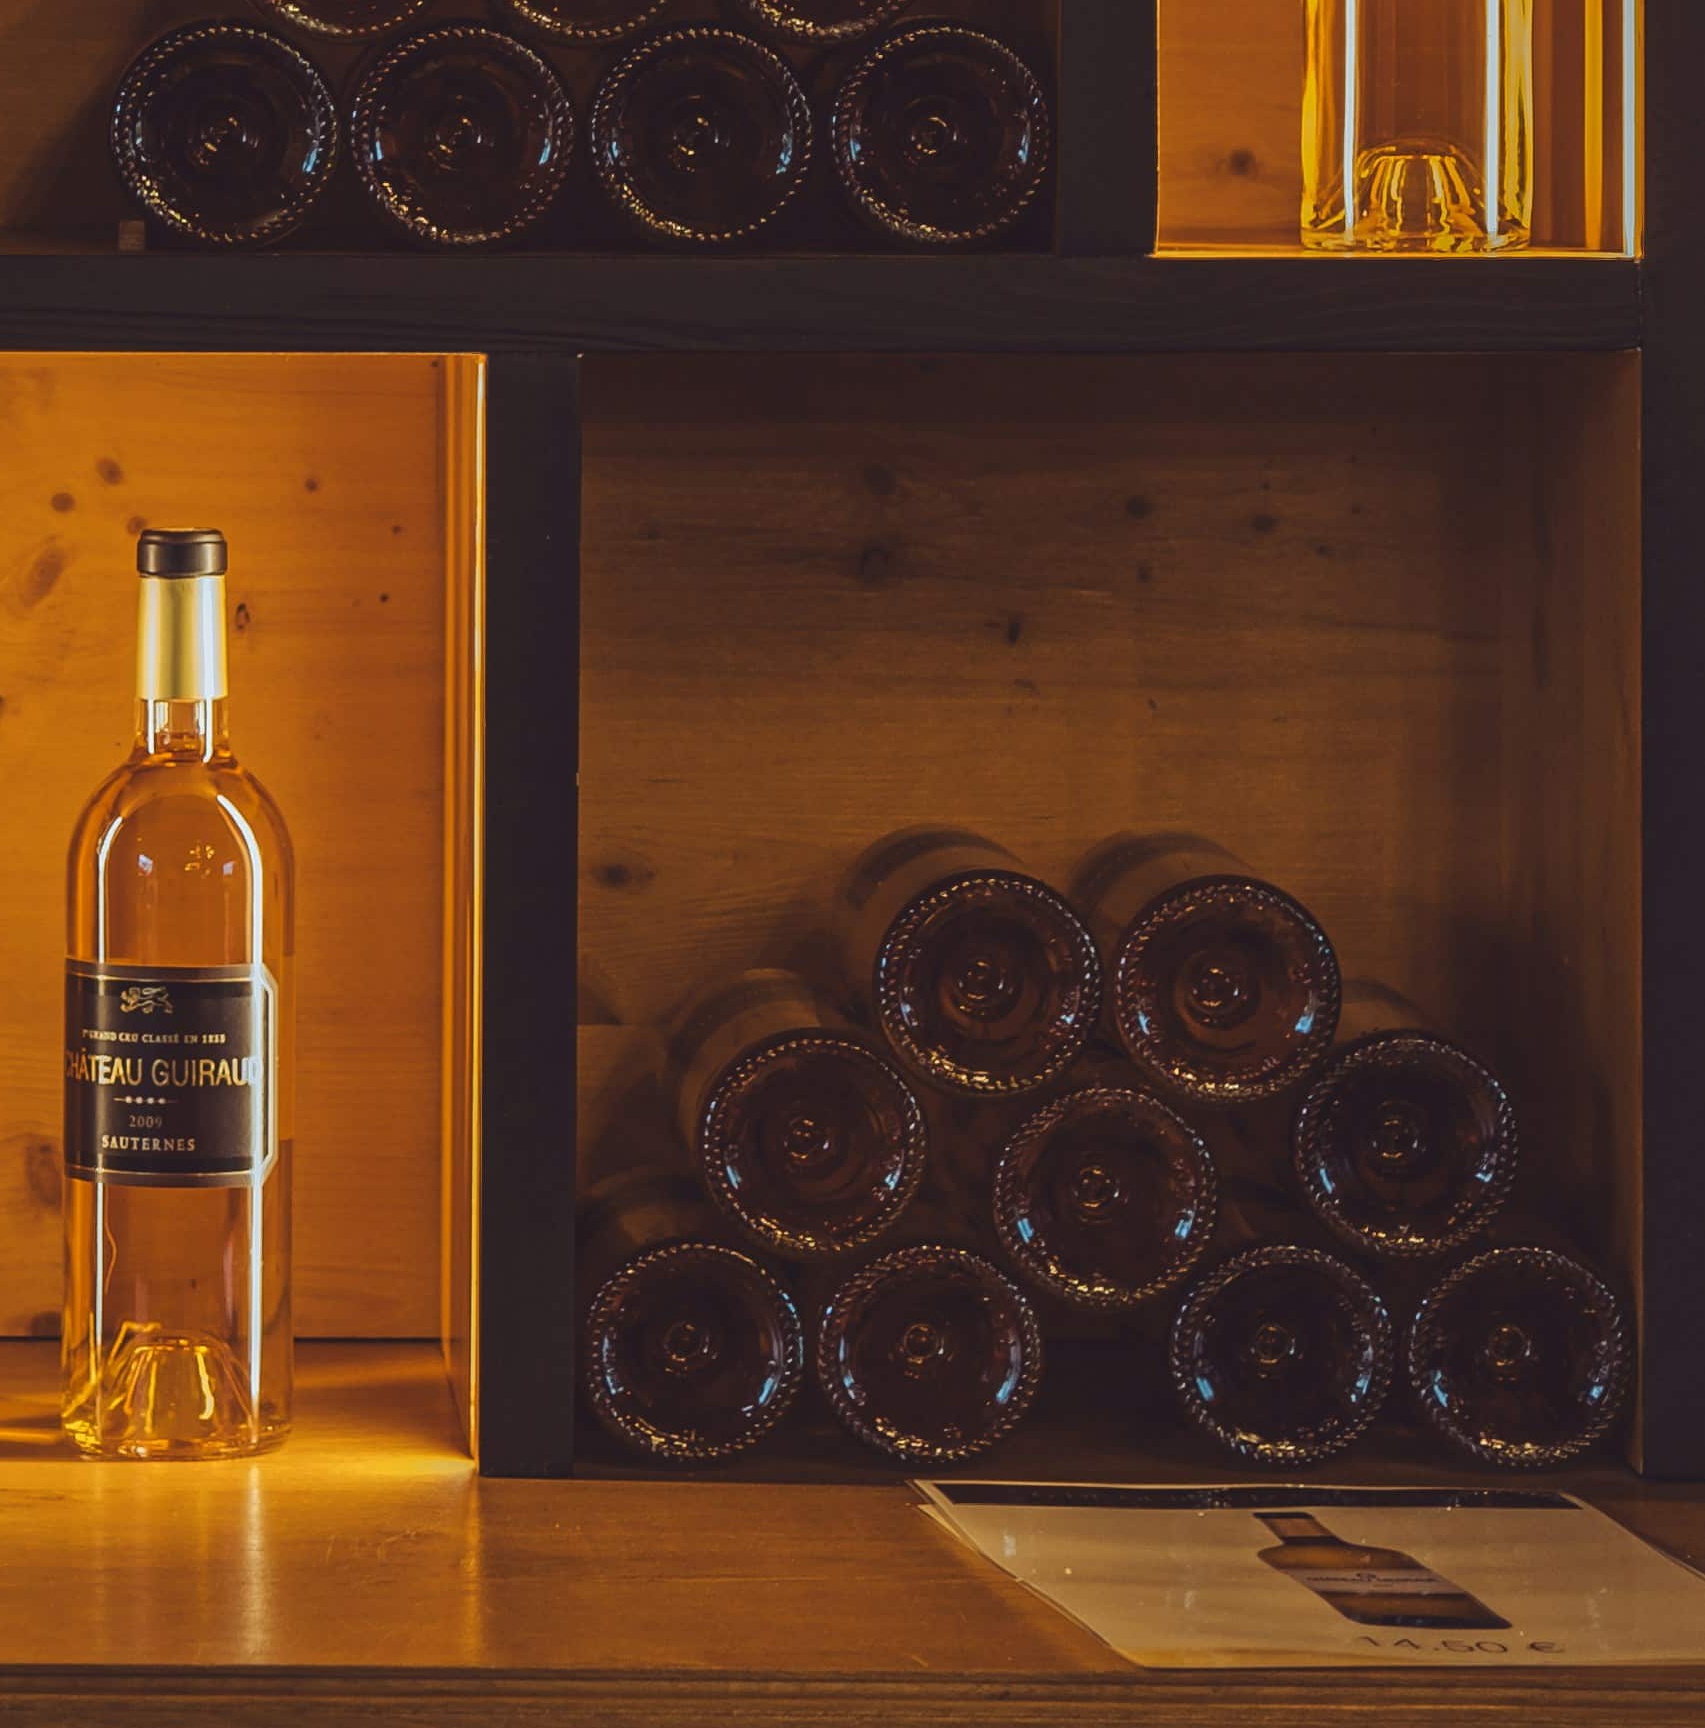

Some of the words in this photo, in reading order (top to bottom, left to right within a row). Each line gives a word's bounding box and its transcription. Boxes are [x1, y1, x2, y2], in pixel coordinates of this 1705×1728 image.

[65, 1047, 143, 1086] CHÂTEAU
[151, 1054, 264, 1087] GUIRAUD
[102, 1134, 196, 1152] SAUTERNES
[1528, 1641, 1565, 1653] €
